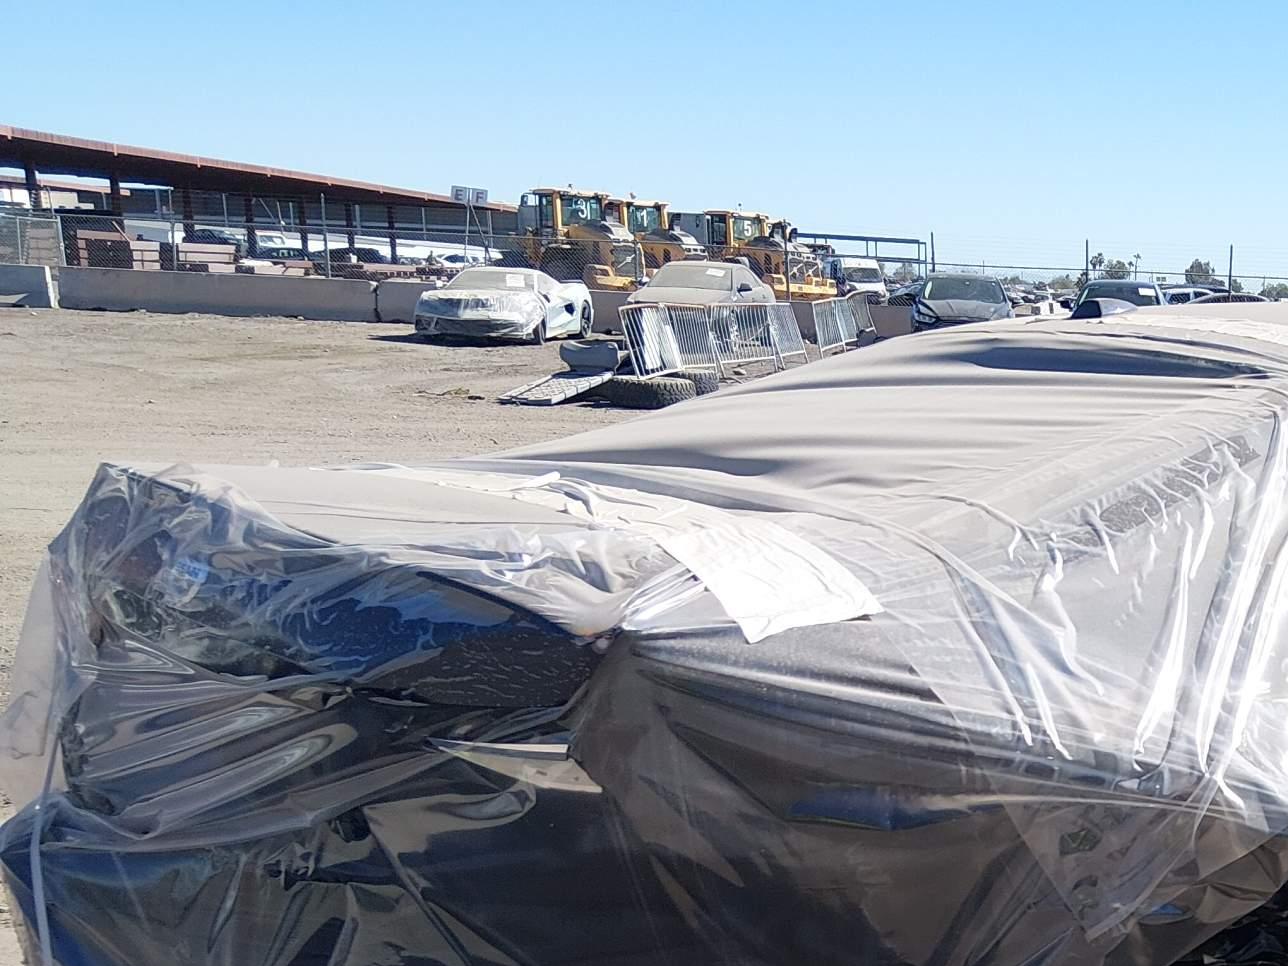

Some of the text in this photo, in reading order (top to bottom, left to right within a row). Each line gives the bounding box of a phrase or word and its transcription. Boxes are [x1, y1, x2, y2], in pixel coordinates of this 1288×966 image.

[454, 188, 465, 201] E
[476, 191, 485, 203] F
[743, 220, 753, 237] 5
